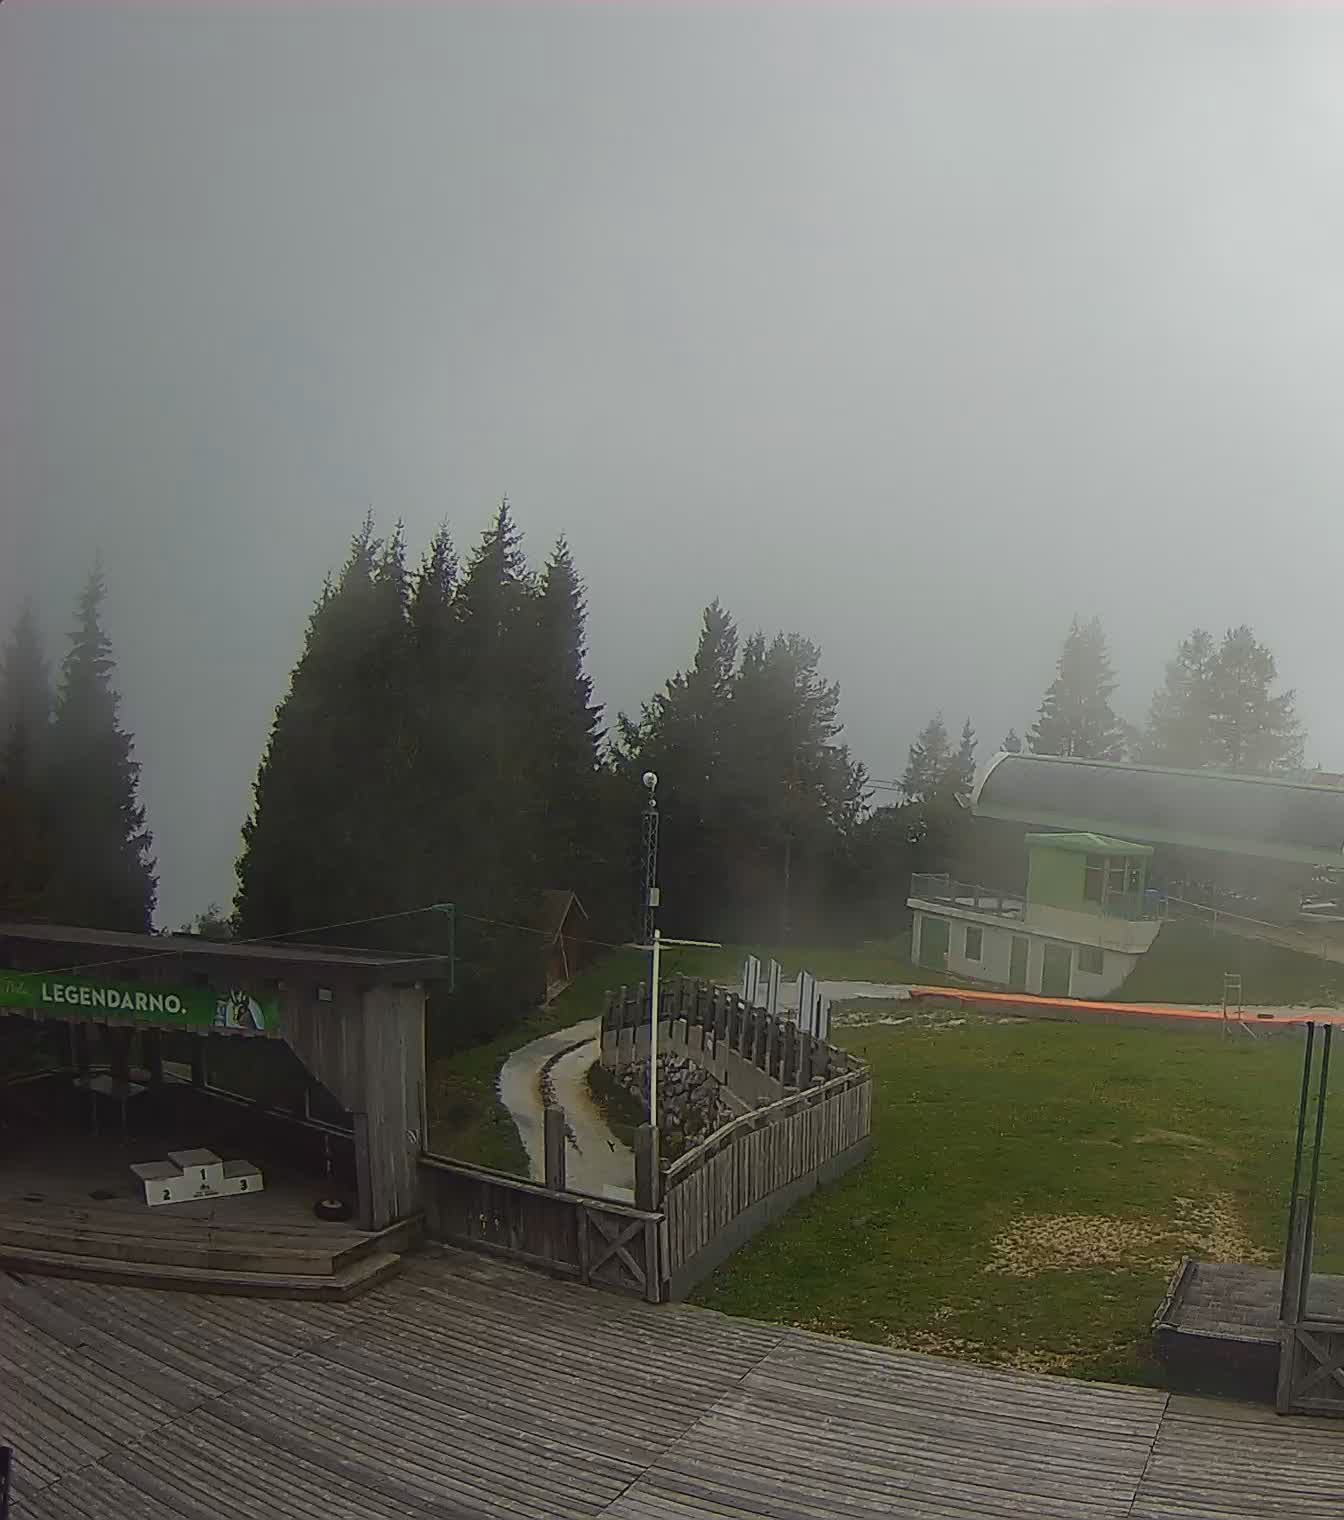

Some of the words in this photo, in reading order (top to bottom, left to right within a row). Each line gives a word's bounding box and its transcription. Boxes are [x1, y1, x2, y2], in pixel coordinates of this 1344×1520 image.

[42, 983, 187, 1015] LEGENDARNO.
[199, 1168, 207, 1181] 1
[239, 1179, 249, 1192] 3
[162, 1189, 171, 1201] 2
